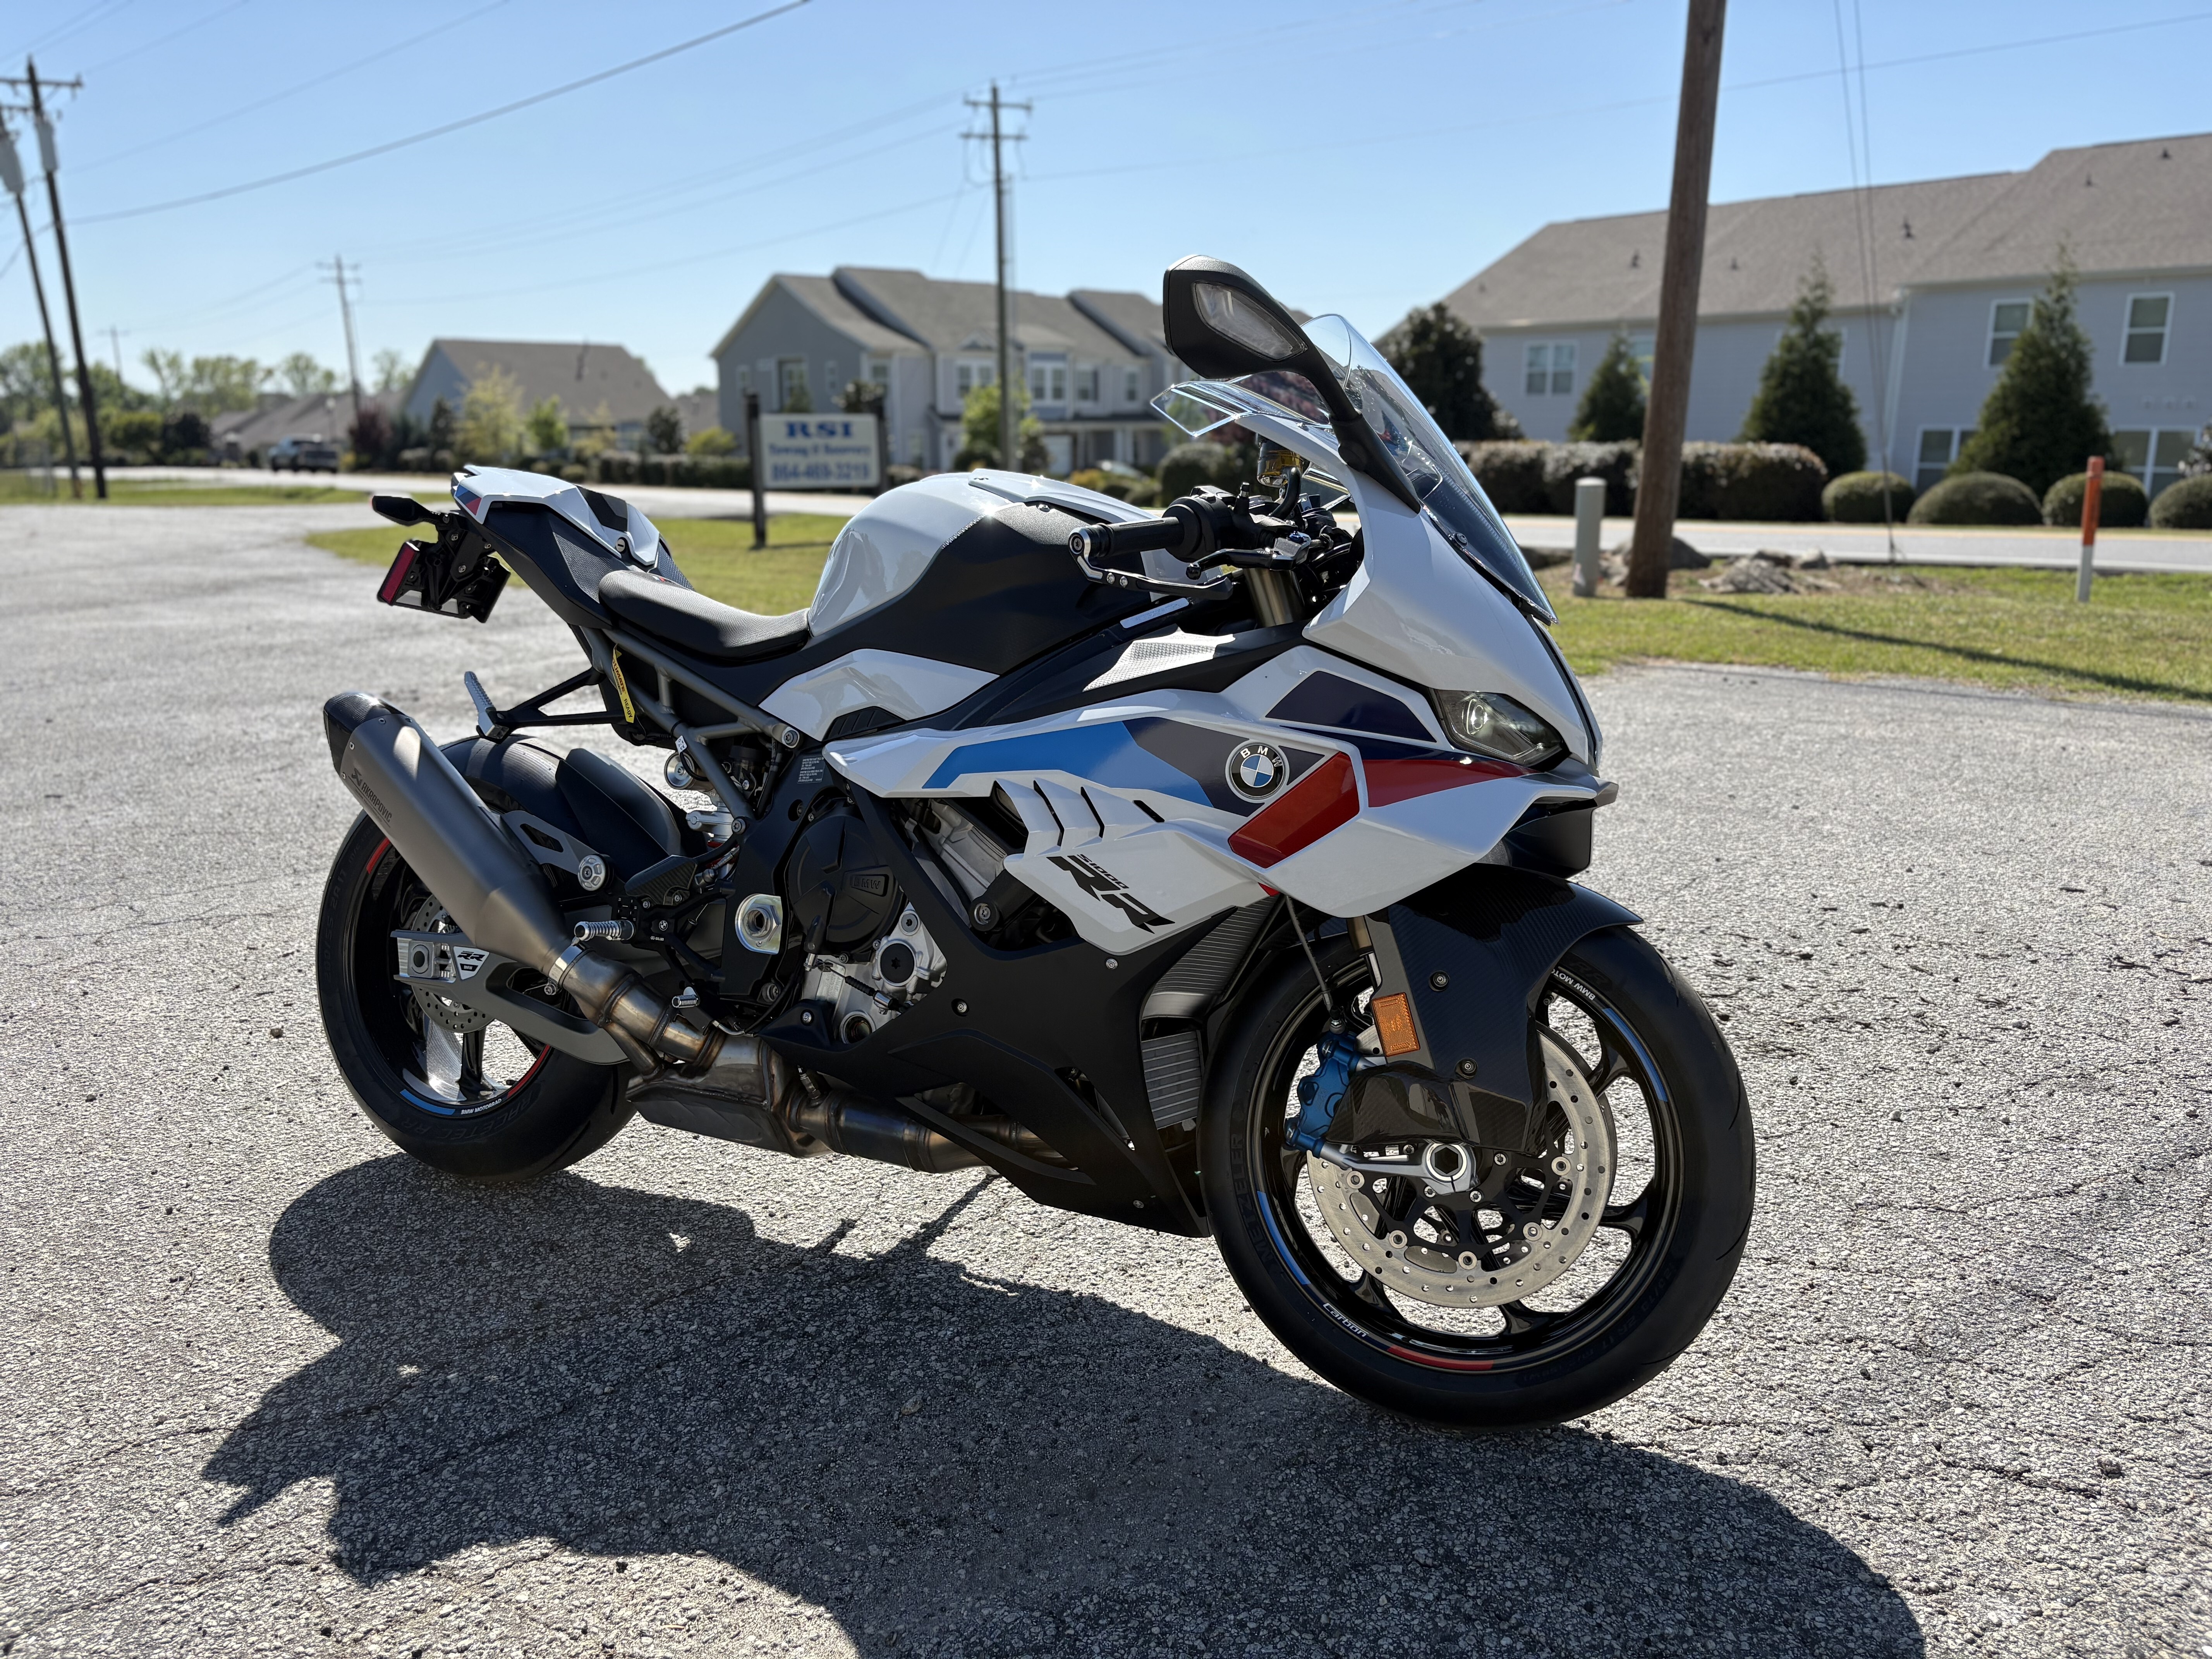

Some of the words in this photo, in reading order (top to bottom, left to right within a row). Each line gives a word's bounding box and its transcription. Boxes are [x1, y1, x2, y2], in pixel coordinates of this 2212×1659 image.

[786, 422, 852, 438] RSI
[623, 699, 633, 718] READY
[1240, 745, 1283, 767] BMW
[1077, 854, 1129, 888] S1000
[854, 877, 881, 890] BMW
[1046, 855, 1175, 934] RR
[457, 952, 485, 962] RR
[1573, 983, 1596, 1001] BMW
[474, 1097, 502, 1114] MOTORRAD
